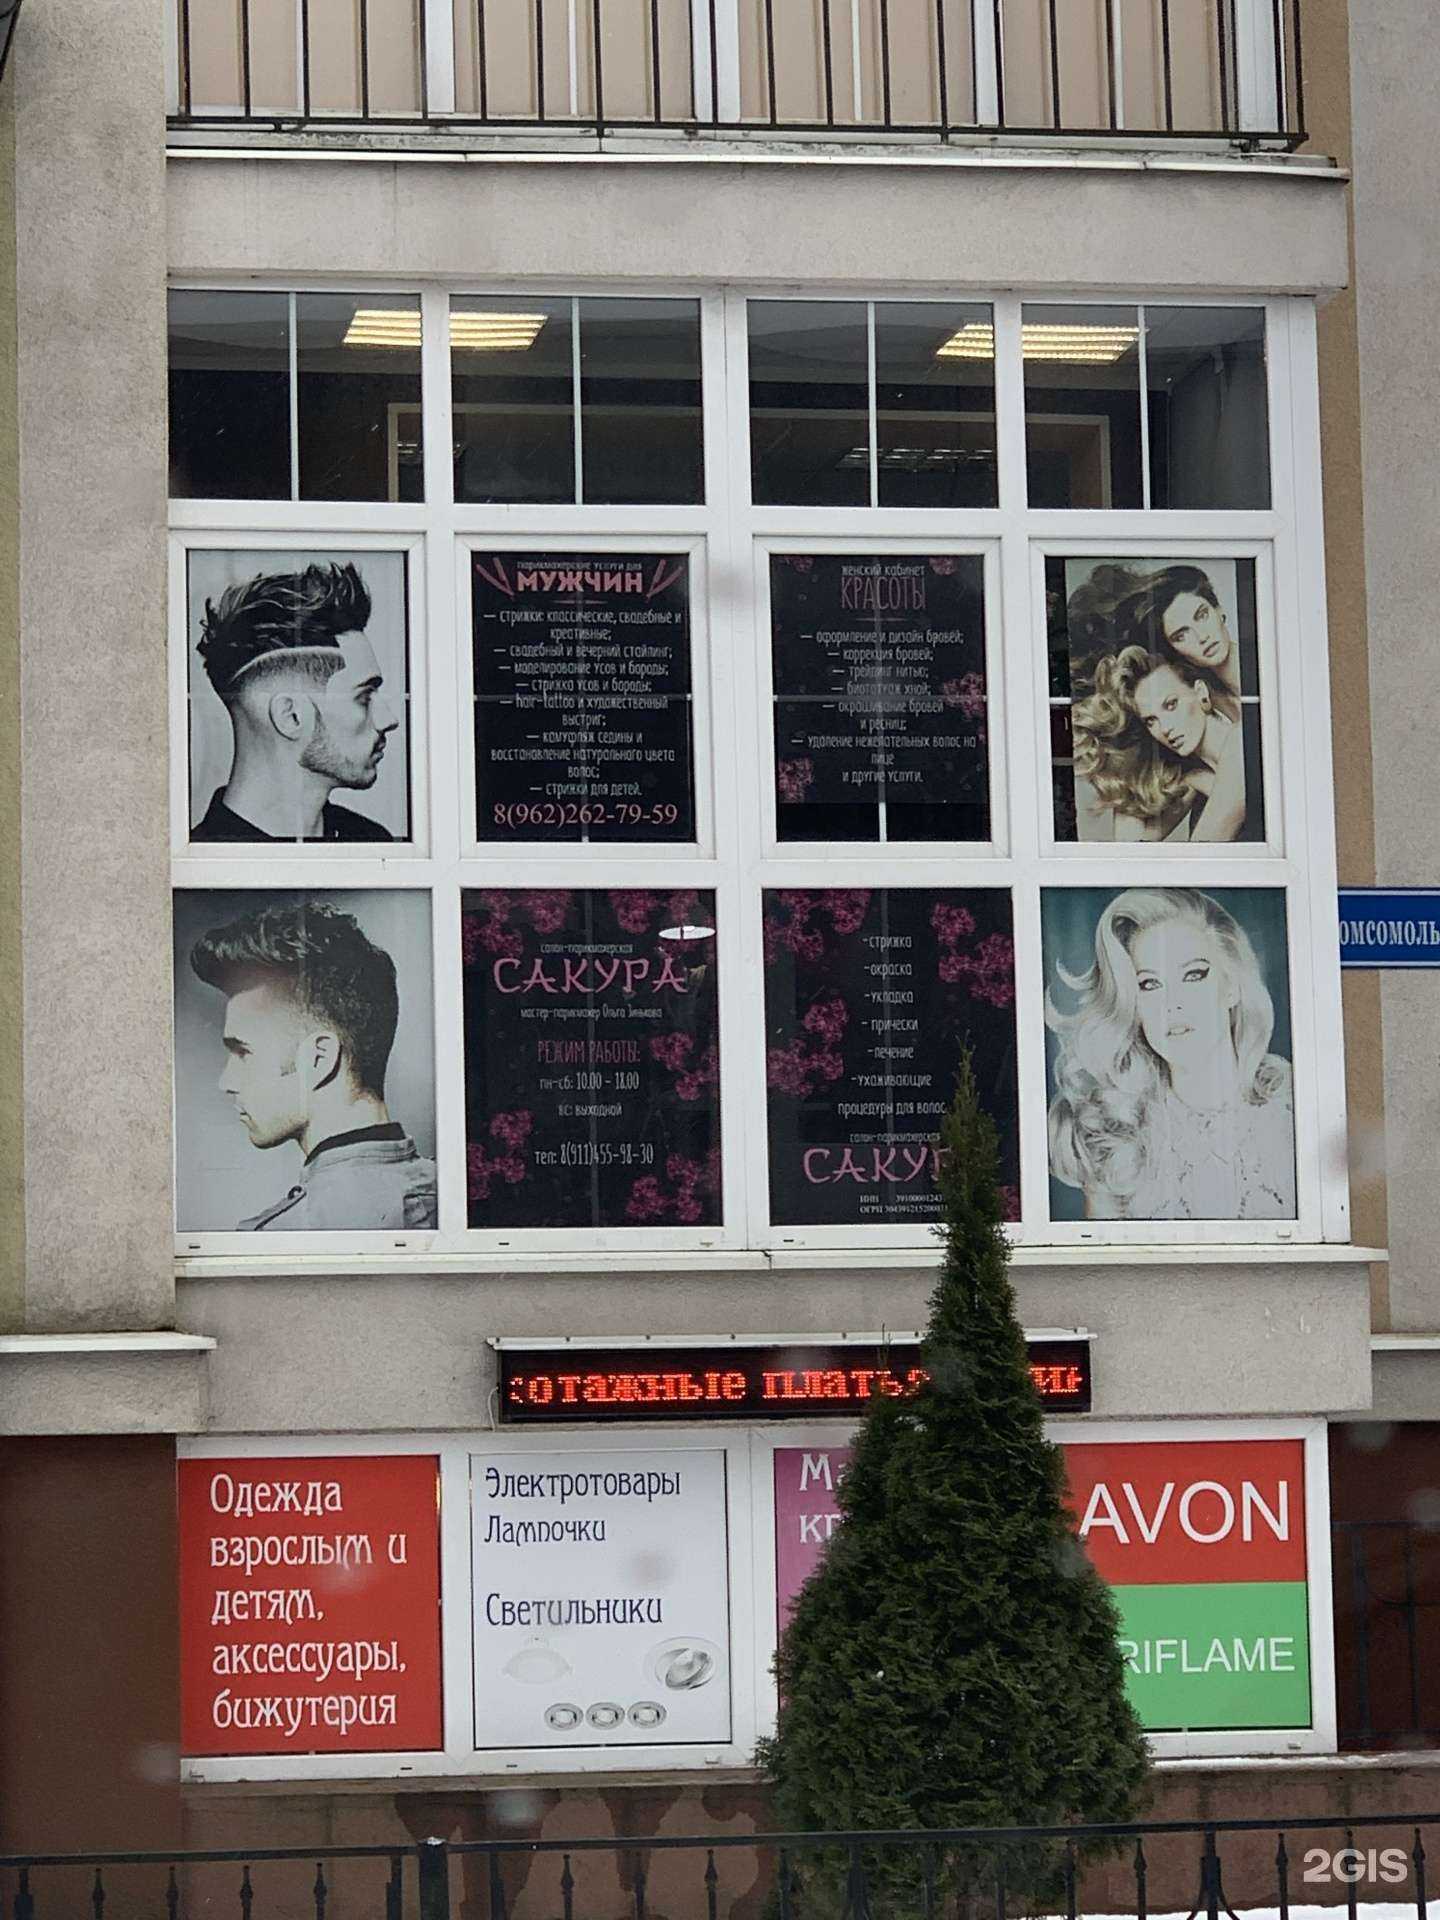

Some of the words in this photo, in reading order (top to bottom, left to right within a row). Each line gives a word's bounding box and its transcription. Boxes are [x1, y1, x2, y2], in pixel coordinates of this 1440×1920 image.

[841, 563, 881, 576] женский
[884, 563, 925, 576] кабинет
[517, 571, 643, 593] МУЖЧИН
[841, 577, 926, 609] КРАСОТЫ
[547, 611, 617, 625] классические,
[619, 609, 672, 624] свадебные
[675, 612, 681, 623] и
[816, 631, 877, 647] оформление
[879, 632, 885, 643] и
[889, 630, 924, 645] дизайн
[926, 629, 964, 647] бровей;
[510, 643, 564, 658] свадебный
[567, 646, 573, 656] и
[576, 644, 621, 660] вечерний
[843, 649, 893, 664] коррекция
[896, 647, 934, 664] бровей;
[514, 663, 590, 678] моделирование
[594, 663, 616, 675] усов
[620, 663, 626, 674] и
[628, 661, 669, 679] бороды;
[531, 679, 574, 695] стрижка
[576, 679, 600, 692] усов
[602, 680, 609, 691] и
[612, 677, 652, 696] бороды;
[846, 681, 900, 696] биотатуаж
[578, 698, 584, 708] и
[587, 696, 668, 710] художественный
[838, 700, 907, 717] окрашивание
[909, 698, 943, 718] бровей
[562, 714, 607, 729] выстриг;
[860, 719, 866, 730] и
[542, 732, 594, 747] камуфляж
[598, 732, 634, 745] седины
[636, 733, 643, 743] и
[808, 736, 852, 749] удаление
[855, 736, 930, 748] нежелательных
[932, 736, 960, 747] волос
[964, 736, 976, 747] на
[491, 749, 571, 761] восстановление
[573, 749, 642, 764] натурального
[645, 749, 675, 763] цвета
[871, 754, 895, 766] лице
[842, 771, 849, 782] и
[851, 771, 885, 787] другие
[546, 783, 588, 799] стрижки
[590, 783, 608, 797] для
[494, 803, 678, 830] 8(962)262-79-59
[1340, 920, 1440, 946] ОМСОМОЛЬ
[862, 935, 912, 952] -стрижка
[493, 957, 689, 993] САКУРА
[864, 963, 912, 980] -окраска
[864, 990, 914, 1004] -укладка
[537, 1040, 585, 1063] РЕЖИМ
[868, 1047, 914, 1060] -лечение
[576, 1071, 602, 1090] 10.00
[615, 1071, 640, 1090] 18.00
[851, 1073, 932, 1088] -ухаживающие
[575, 1102, 622, 1117] выходной
[838, 1102, 893, 1119] процедуры
[896, 1102, 914, 1116] для
[534, 1149, 557, 1165] тел:
[560, 1141, 654, 1167] 8(911)455-98-30
[486, 1467, 680, 1503] Электротовары
[210, 1473, 343, 1517] Одежда
[1078, 1480, 1289, 1544] AVON
[484, 1514, 606, 1547] Лампочки
[210, 1534, 373, 1576] взрослым
[388, 1534, 407, 1564] и
[211, 1588, 324, 1626] детям,
[486, 1594, 662, 1627] Светильники
[212, 1641, 407, 1682] аксессуары,
[1117, 1637, 1295, 1675] RIFLAME
[213, 1688, 397, 1736] бижутерия
